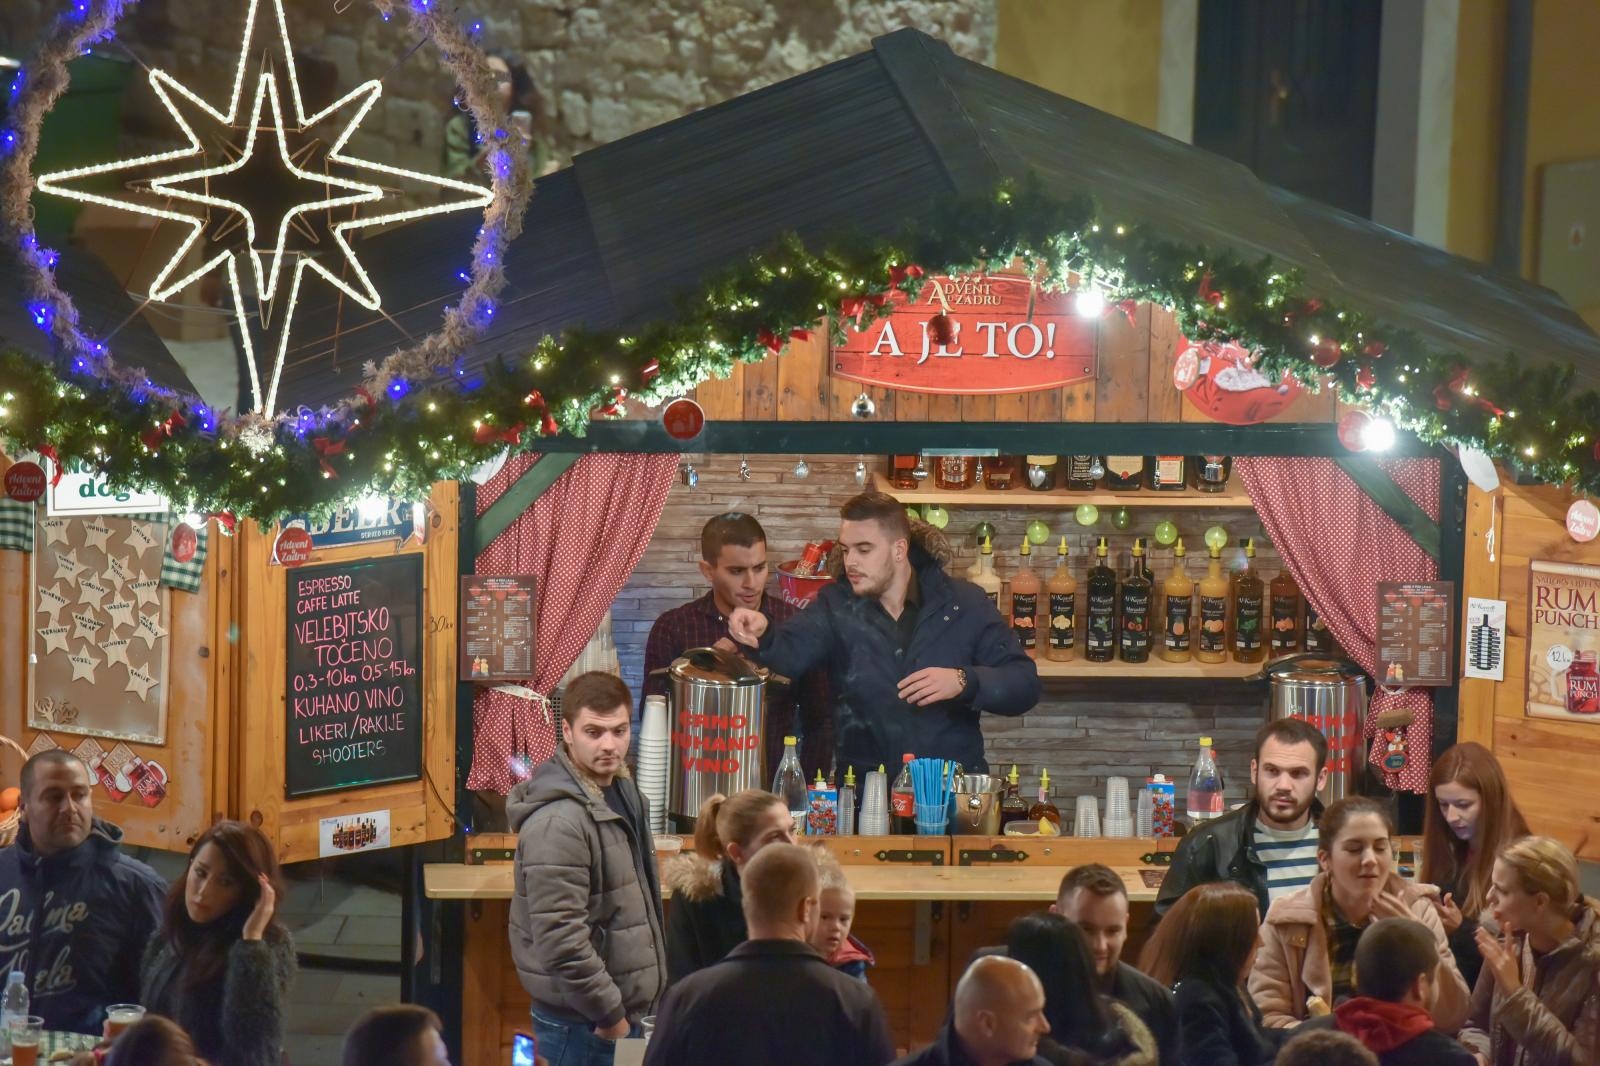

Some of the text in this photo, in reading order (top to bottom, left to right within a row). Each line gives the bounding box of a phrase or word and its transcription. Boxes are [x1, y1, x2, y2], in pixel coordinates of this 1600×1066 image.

[926, 279, 992, 312] ADVENT
[955, 294, 1002, 305] ZADRU
[869, 321, 904, 356] A
[976, 321, 1056, 360] TO!
[298, 575, 352, 597] ESPRESSO
[297, 590, 361, 614] CAFFE LATTE
[1536, 586, 1599, 614] RUM
[295, 606, 390, 645] VELEBITSKO
[1535, 610, 1600, 630] PUNCH
[314, 637, 393, 668] TOČENO
[1570, 680, 1597, 692] RUM
[294, 686, 404, 720] KUHANO VINO
[313, 740, 386, 766] SHOOTERS
[683, 757, 740, 773] VINO
